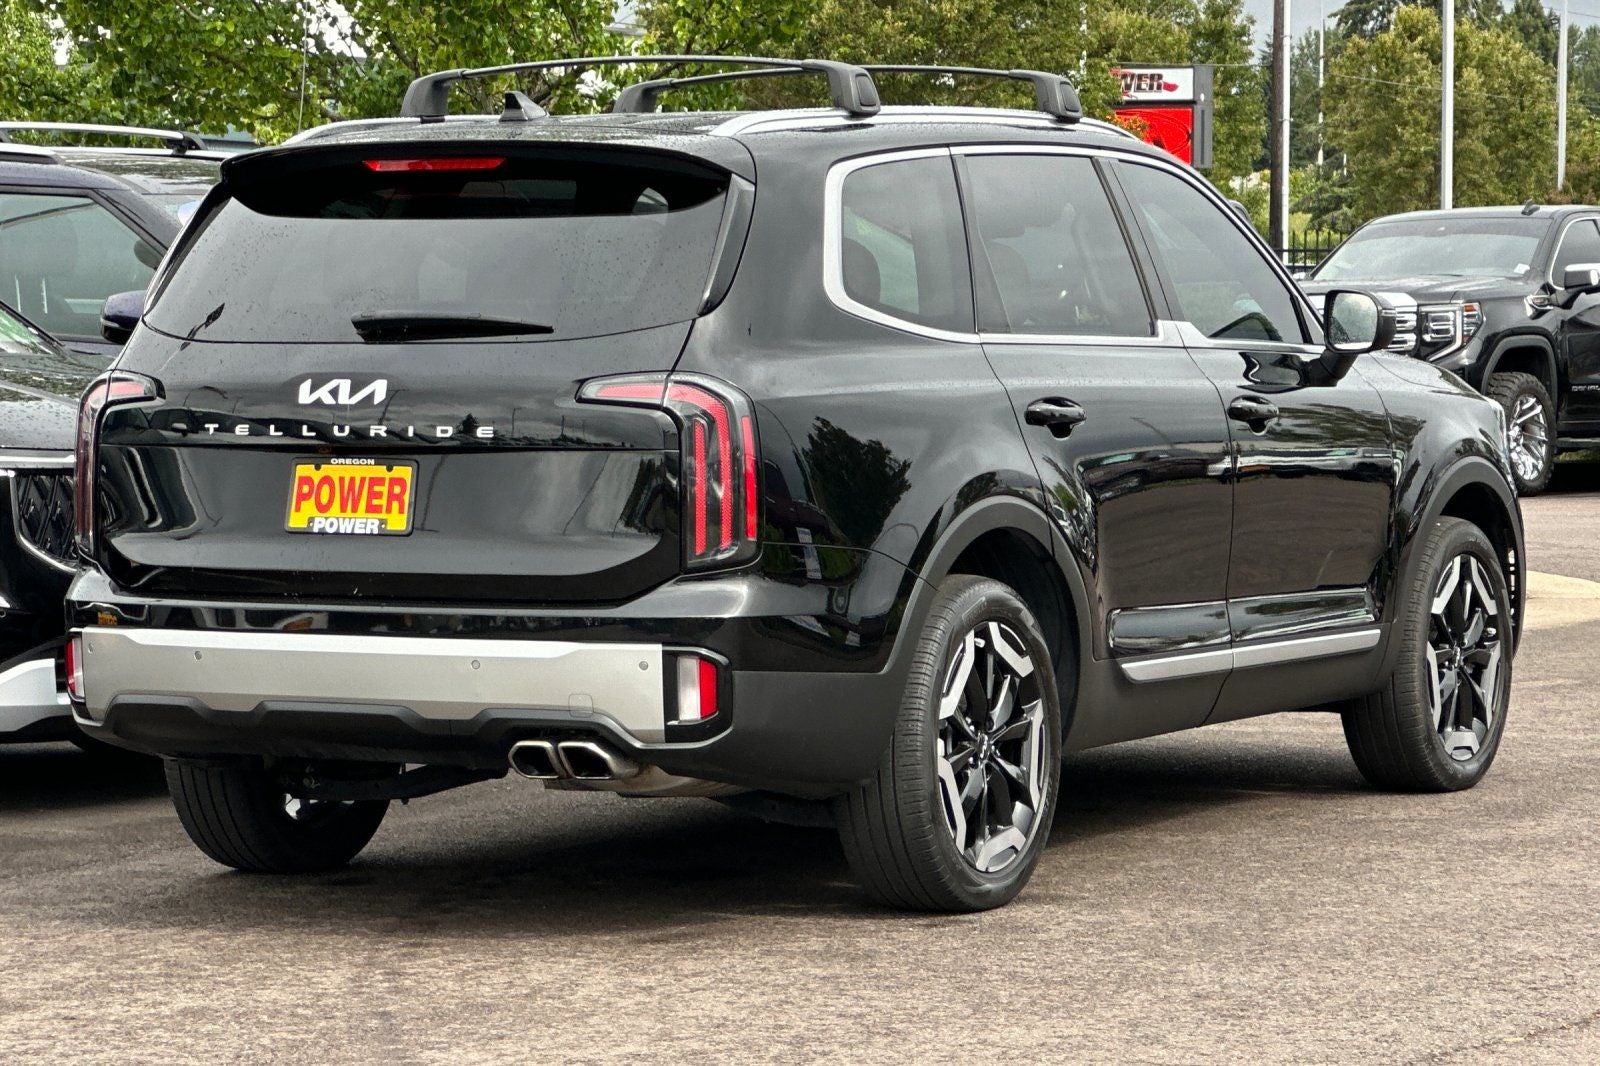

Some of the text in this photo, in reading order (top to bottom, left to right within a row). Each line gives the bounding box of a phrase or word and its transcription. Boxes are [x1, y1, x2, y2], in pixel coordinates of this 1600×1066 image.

[298, 378, 388, 405] KIA
[204, 423, 495, 438] TELLURIDE
[294, 474, 408, 515] POWER
[313, 516, 380, 534] POWER
